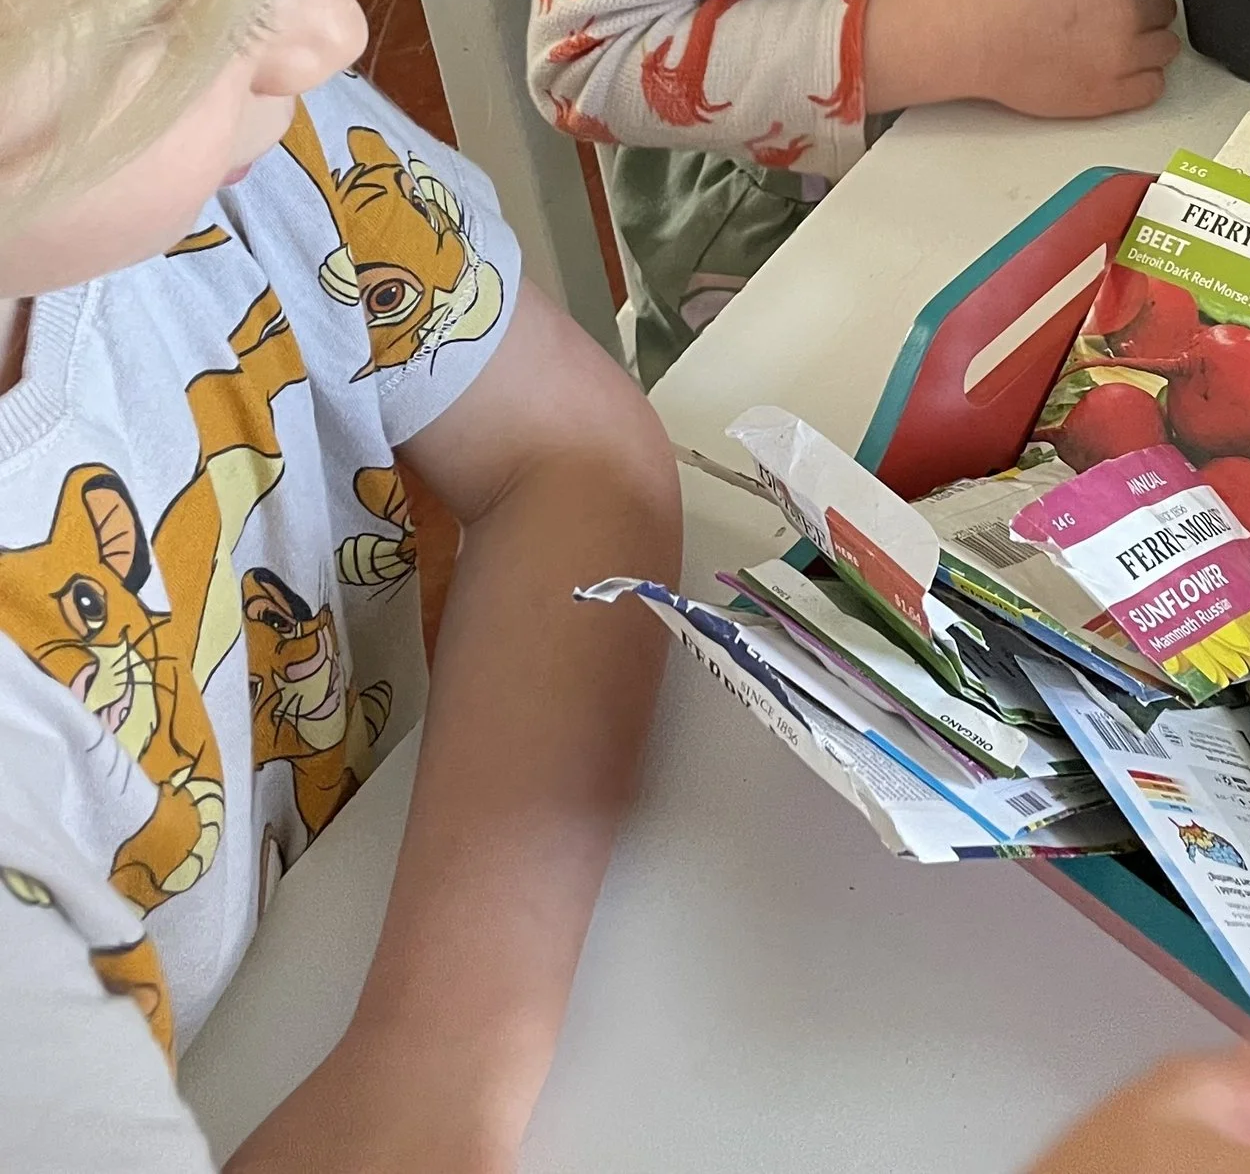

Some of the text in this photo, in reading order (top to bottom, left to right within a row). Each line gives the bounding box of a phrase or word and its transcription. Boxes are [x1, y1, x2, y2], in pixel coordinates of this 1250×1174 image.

[1136, 223, 1190, 259] BEET
[1127, 246, 1164, 270] Detroit
[1163, 260, 1191, 280] Dark
[1190, 271, 1214, 289] Red
[1127, 561, 1229, 633] SUNFLOWER
[1147, 594, 1232, 653] Mammoth Russian
[740, 681, 800, 746] SINCE 1856
[939, 713, 994, 752] OREGANO
